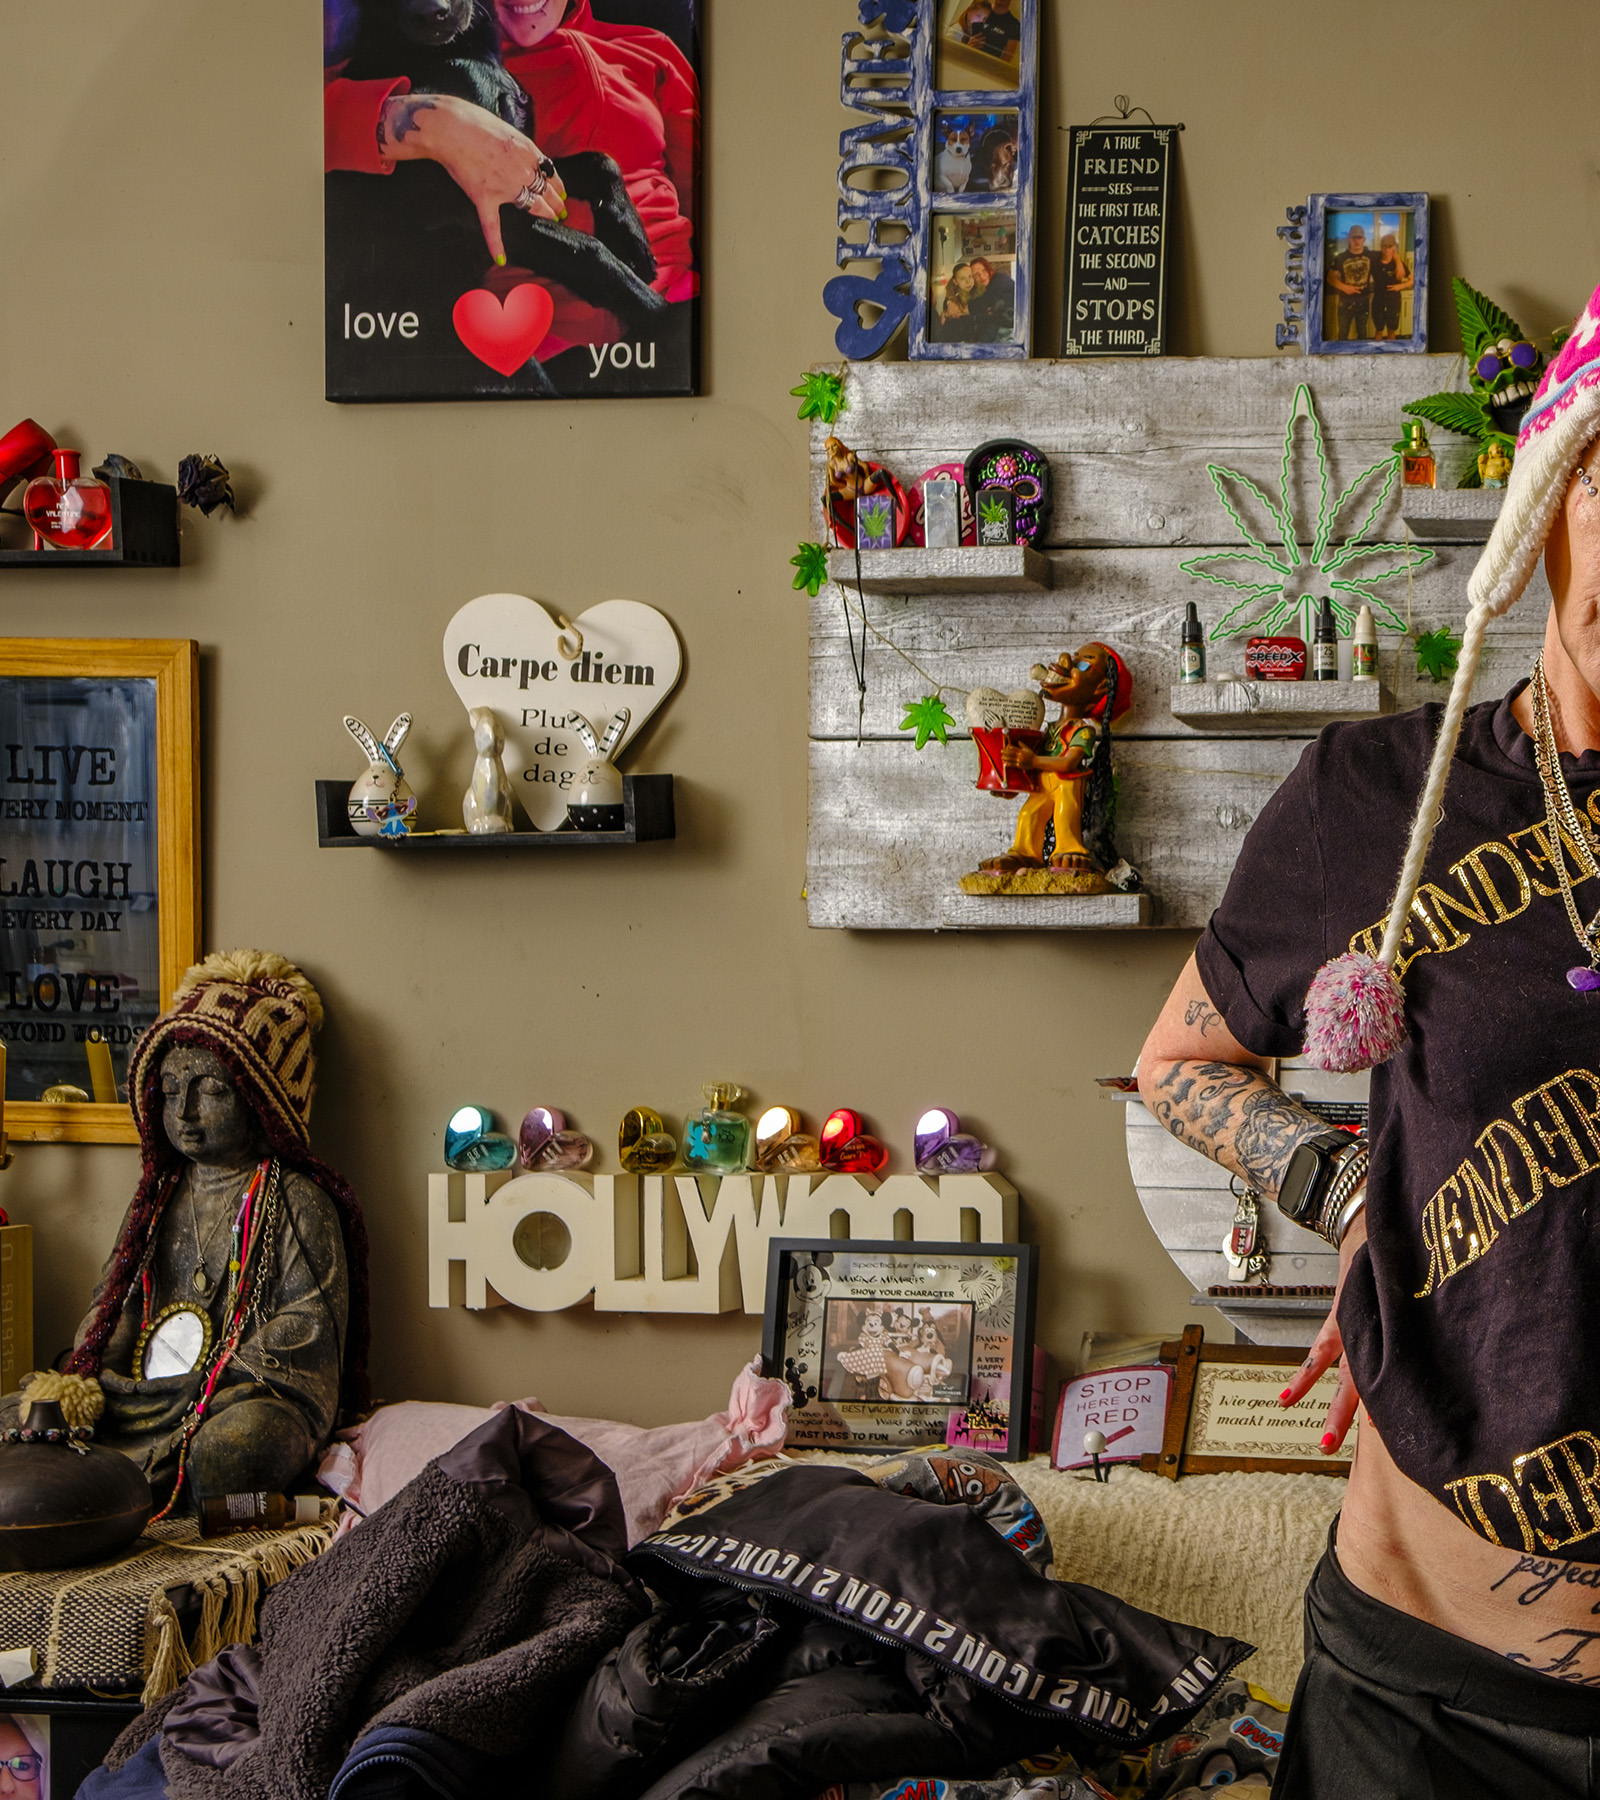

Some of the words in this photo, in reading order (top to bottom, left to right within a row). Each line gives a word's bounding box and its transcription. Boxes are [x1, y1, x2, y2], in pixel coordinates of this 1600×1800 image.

[836, 31, 915, 271] HOME
[1103, 136, 1111, 150] A
[1114, 136, 1142, 150] TRUE
[1083, 158, 1160, 175] FRIEND
[1108, 183, 1132, 195] SEES
[1078, 203, 1097, 217] THE
[1100, 203, 1129, 217] FIRST
[1132, 203, 1161, 217] TEAR.
[1077, 225, 1160, 245] CATCHES
[1079, 253, 1102, 269] THE
[1106, 253, 1156, 269] SECOND
[1104, 277, 1127, 291] AND
[1076, 299, 1155, 321] STOPS
[344, 304, 419, 340] love
[589, 342, 657, 379] you
[1080, 330, 1103, 345] THE
[1107, 329, 1148, 345] THIRD.
[457, 643, 559, 690] Carpe
[570, 651, 656, 686] diem
[520, 708, 572, 730] Plu
[534, 737, 569, 757] de
[5, 744, 117, 786] LIVE
[523, 763, 577, 791] dag
[55, 800, 148, 822] MOMENT
[0, 858, 133, 901] LAUGH
[1, 909, 75, 931] EVERY
[80, 911, 123, 933] DAY
[5, 971, 120, 1014] LOVE
[72, 1023, 146, 1045] WORDS
[913, 1262, 960, 1271] fireworks
[850, 1288, 876, 1296] SHOW
[879, 1288, 902, 1297] YOUR
[904, 1289, 955, 1298] CHARACTER
[977, 1364, 1004, 1372] HAPPY
[977, 1371, 1003, 1379] PLACE
[1080, 1376, 1151, 1398] STOP
[841, 1404, 866, 1413] BEST
[868, 1405, 911, 1415] VACATION
[912, 1406, 941, 1416] EVER
[1077, 1395, 1121, 1412] HERE
[1127, 1394, 1152, 1405] ON
[1219, 1395, 1246, 1407] Wie
[1084, 1408, 1139, 1427] RED
[1216, 1415, 1263, 1428] maakt
[795, 1430, 820, 1439] FAST
[822, 1431, 849, 1440] PASS
[852, 1432, 866, 1440] TO
[868, 1433, 889, 1441] FUN
[730, 1542, 816, 1588] ICON
[836, 1577, 927, 1638] ICON
[952, 1634, 1046, 1701] ICON
